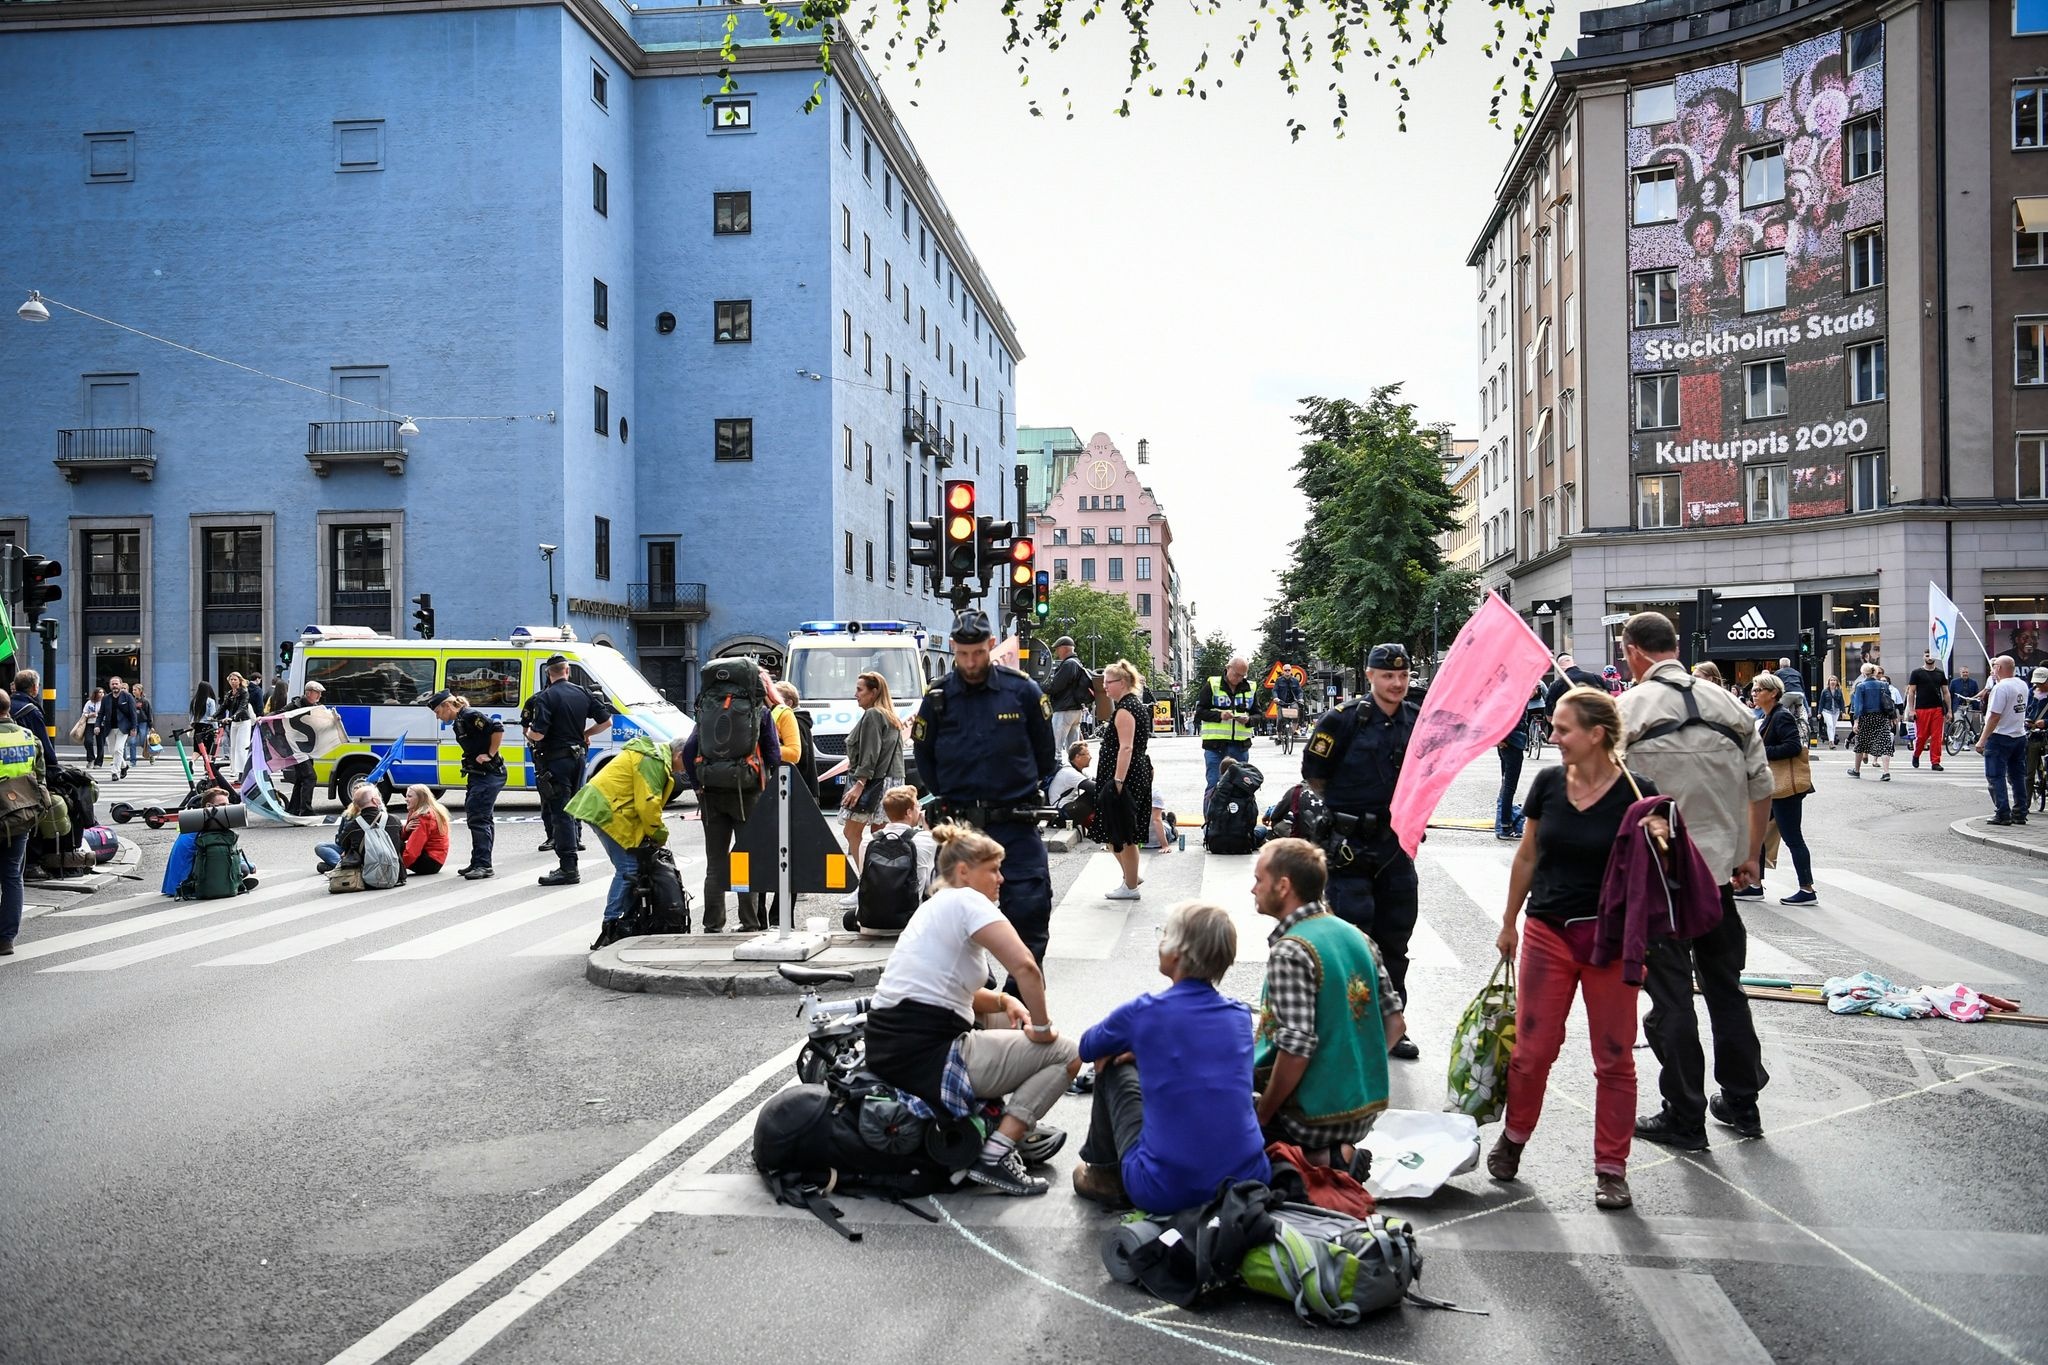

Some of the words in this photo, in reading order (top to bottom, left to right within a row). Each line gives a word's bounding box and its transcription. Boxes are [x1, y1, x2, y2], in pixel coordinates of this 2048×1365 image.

[1644, 325, 1801, 362] Stockholms
[1806, 304, 1876, 339] Stads
[1656, 431, 1789, 464] Kulturpris
[1795, 417, 1868, 452] 2020
[1727, 628, 1775, 640] adidas
[1155, 706, 1168, 715] 30
[0, 745, 31, 760] POLIS
